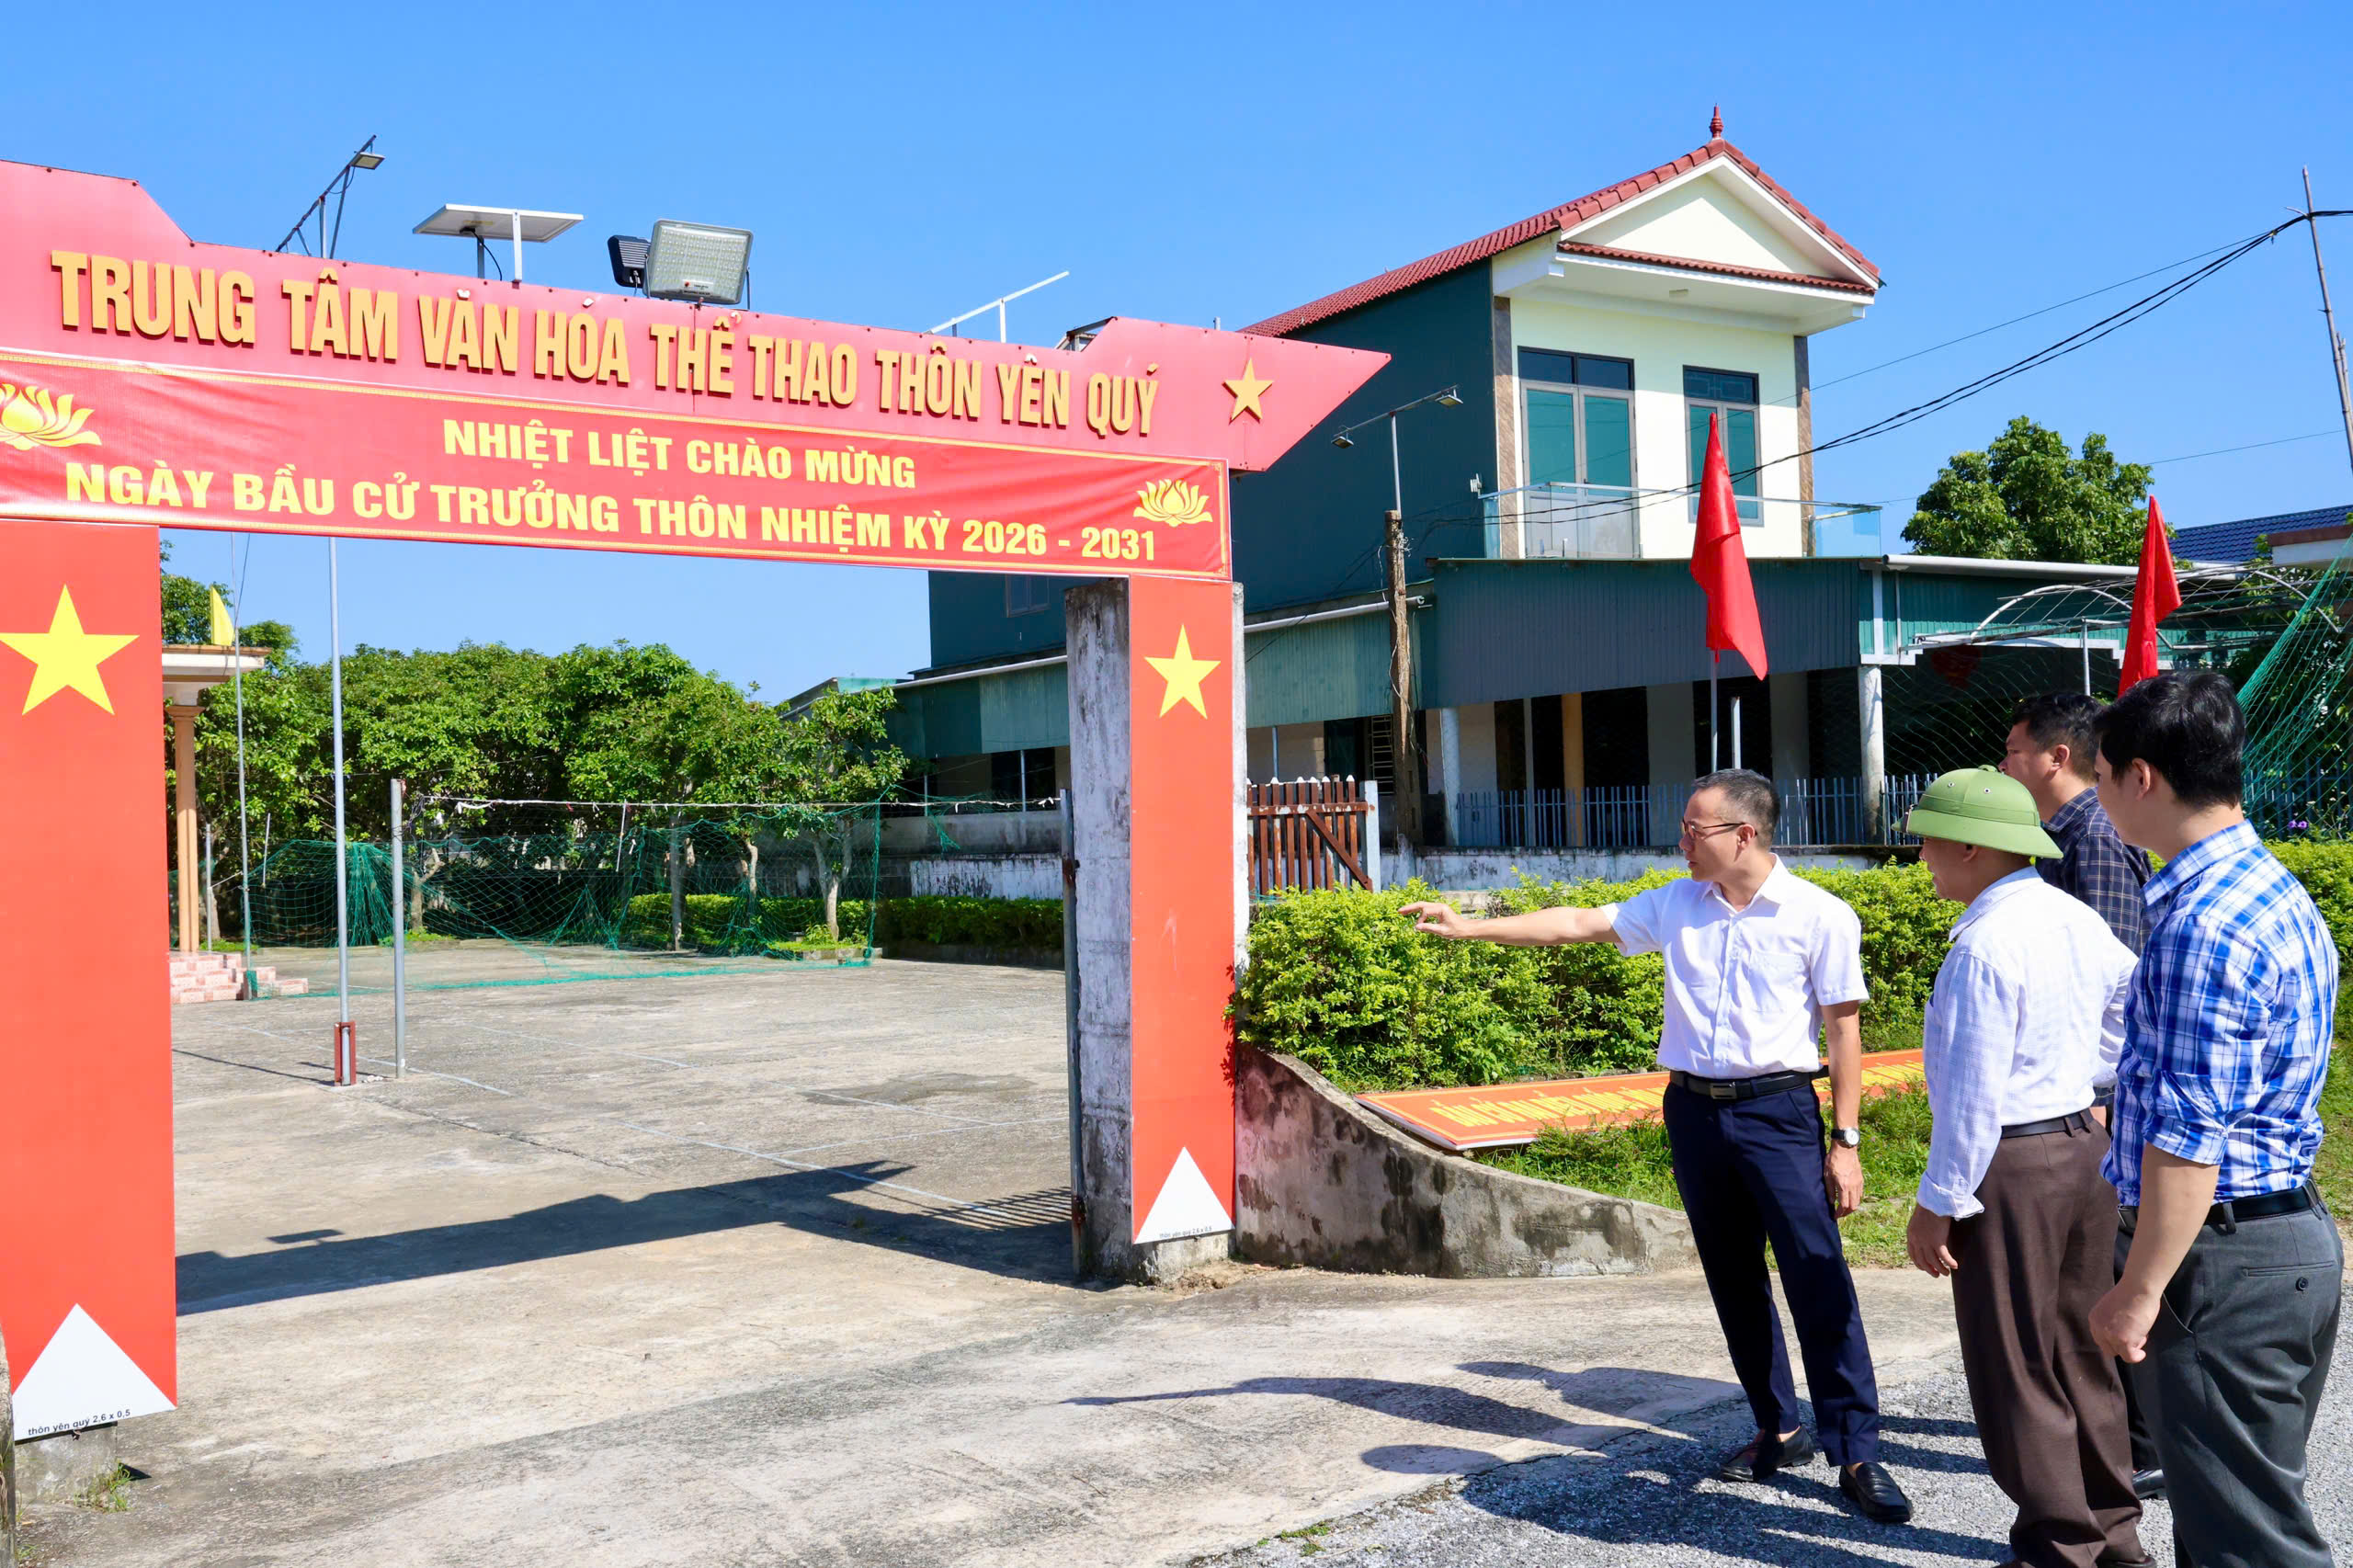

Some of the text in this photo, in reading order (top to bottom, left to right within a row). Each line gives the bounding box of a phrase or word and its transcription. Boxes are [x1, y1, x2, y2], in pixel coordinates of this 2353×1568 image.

[51, 249, 1160, 437] TRUNG TÂM VĂN HÓA THỂ THAO THÔN YÊN QUÝ
[443, 419, 916, 489] NHIỆT LIỆT CHÀO MỪNG
[65, 459, 1155, 561] NGÀY BẦU CỬ TRƯỞNG THÔN NHIỆM KỲ 2026 - 2031
[28, 1426, 51, 1436] thôn
[52, 1422, 70, 1432] yên
